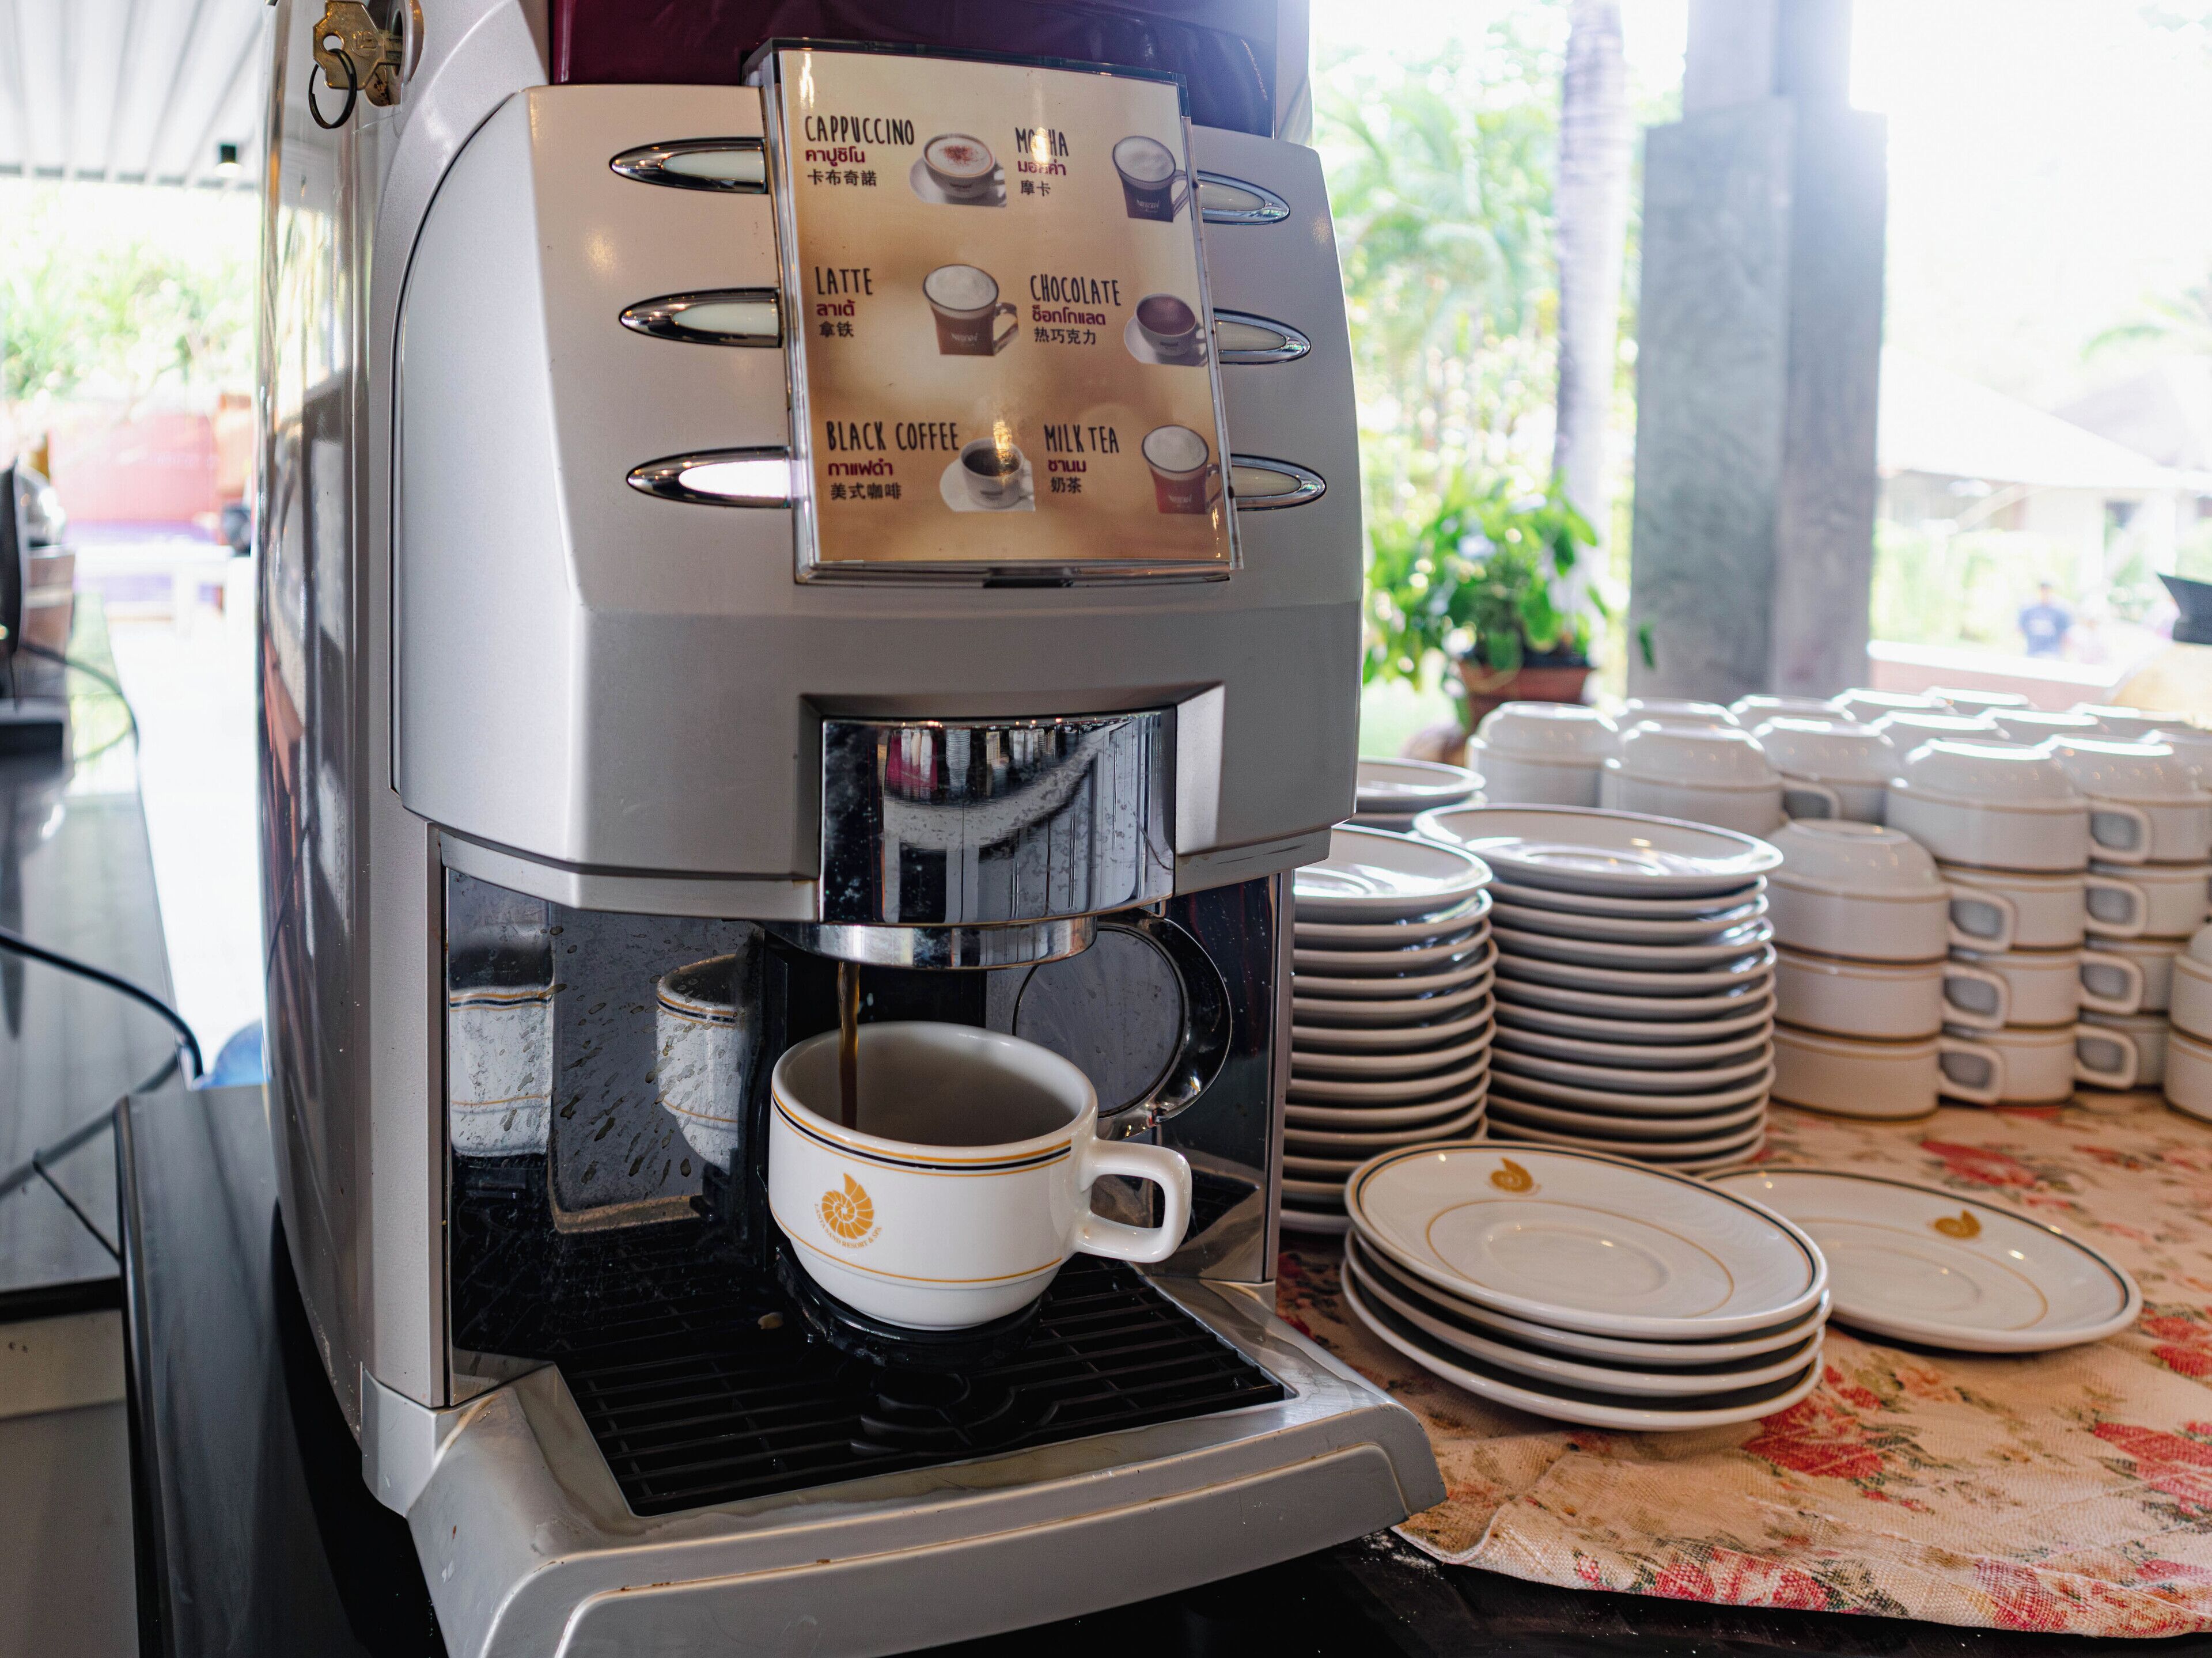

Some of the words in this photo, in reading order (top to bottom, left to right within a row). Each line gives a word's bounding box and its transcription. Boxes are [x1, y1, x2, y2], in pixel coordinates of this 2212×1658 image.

[805, 116, 914, 145] CAPPUCCINO
[1015, 127, 1069, 157] MOHA
[806, 146, 865, 166] คาปูชิโน
[808, 169, 877, 187] 卡布奇諾
[1021, 180, 1051, 196] 摩卡
[815, 267, 873, 295] LATTE
[1031, 274, 1121, 306] CHOCOLATE
[819, 321, 854, 337] 拿铁
[1034, 327, 1096, 345] 热巧克力
[826, 421, 886, 451] BLACK
[896, 422, 959, 451] COFFEE
[1044, 424, 1084, 452] MILK
[1088, 426, 1119, 453] TEA
[828, 458, 893, 476] กาแฟดำ
[831, 483, 901, 500] 美式咖啡
[1051, 477, 1081, 494] 奶茶
